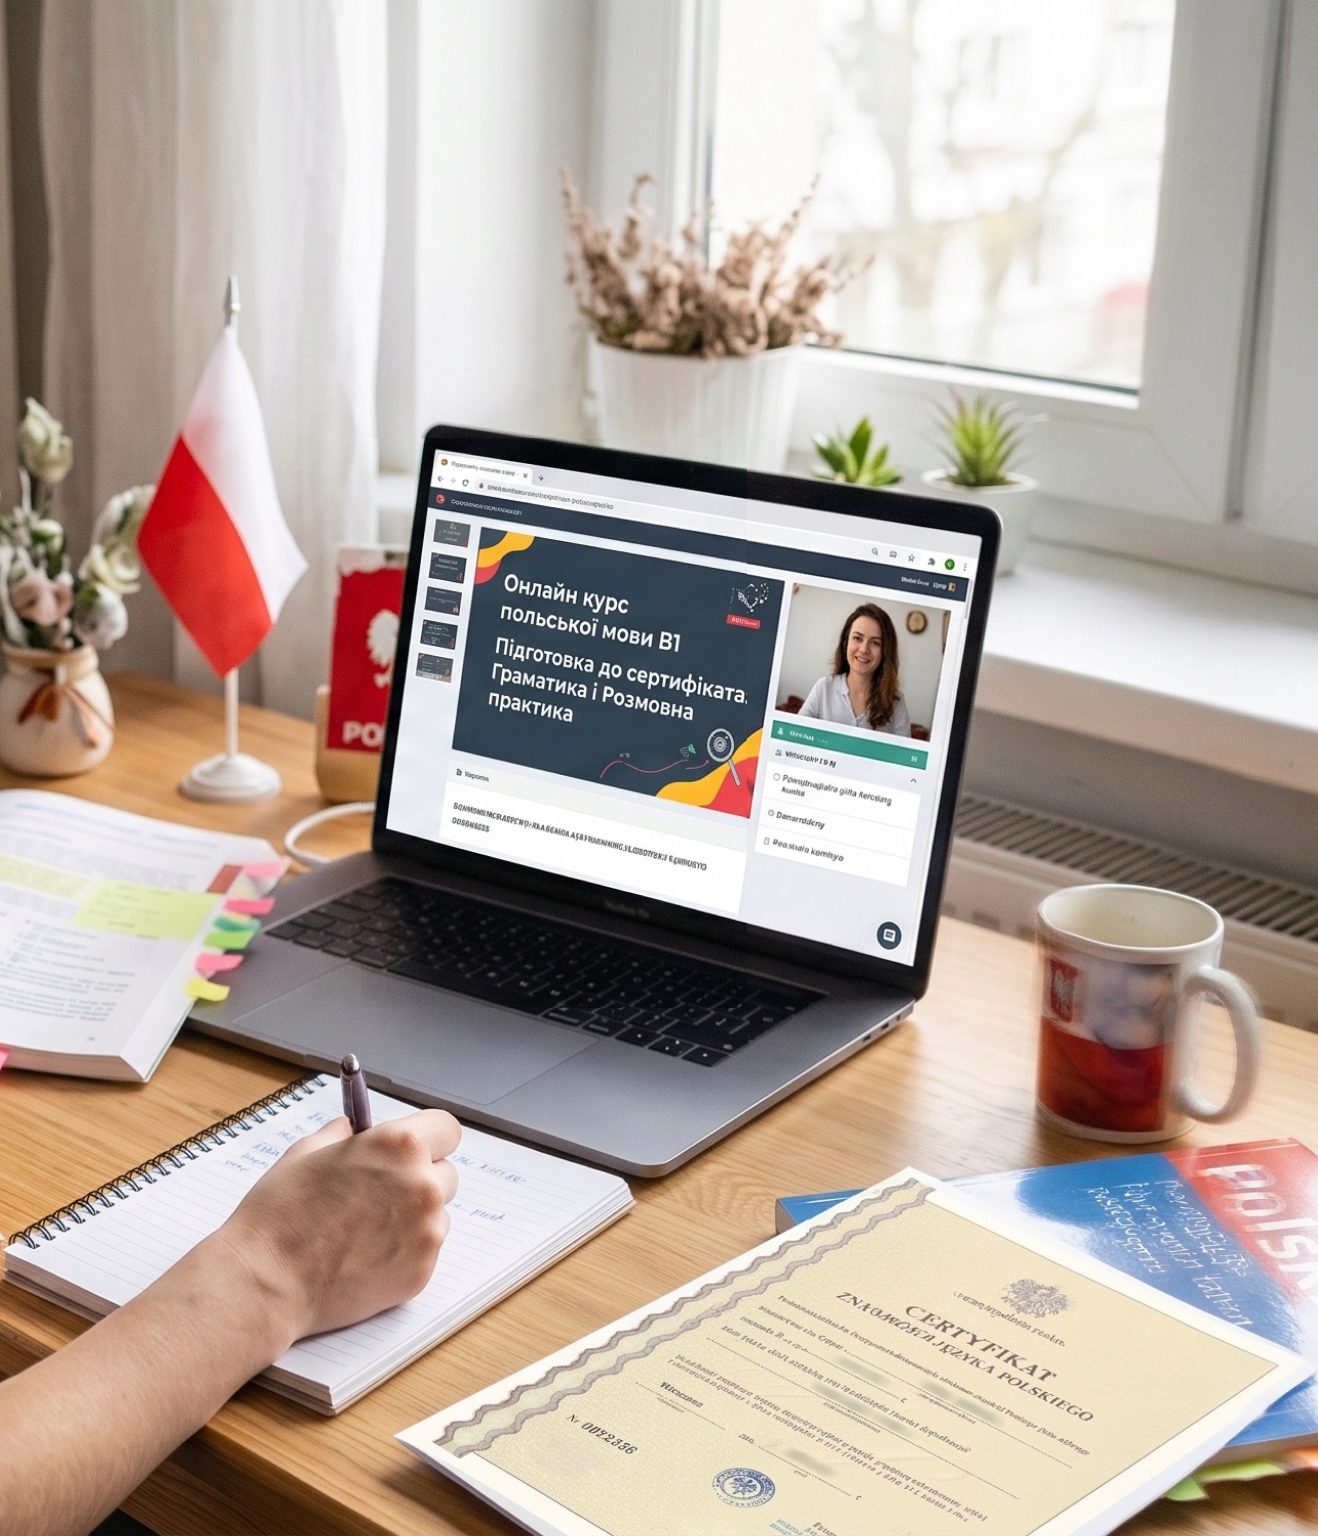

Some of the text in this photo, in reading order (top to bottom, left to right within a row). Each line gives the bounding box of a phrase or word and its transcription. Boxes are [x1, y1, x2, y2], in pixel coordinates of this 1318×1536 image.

[504, 573, 629, 615] Онлайн курс
[500, 605, 599, 637] польської
[602, 624, 654, 648] мови
[495, 636, 595, 673] Підготовка
[598, 661, 622, 680] до
[488, 692, 574, 723] практика
[491, 663, 694, 721] Граматика і Розмовна
[342, 720, 383, 747] PO
[905, 1305, 1058, 1382] CERTYFIKAT
[997, 1371, 1095, 1423] POLSKIEGO
